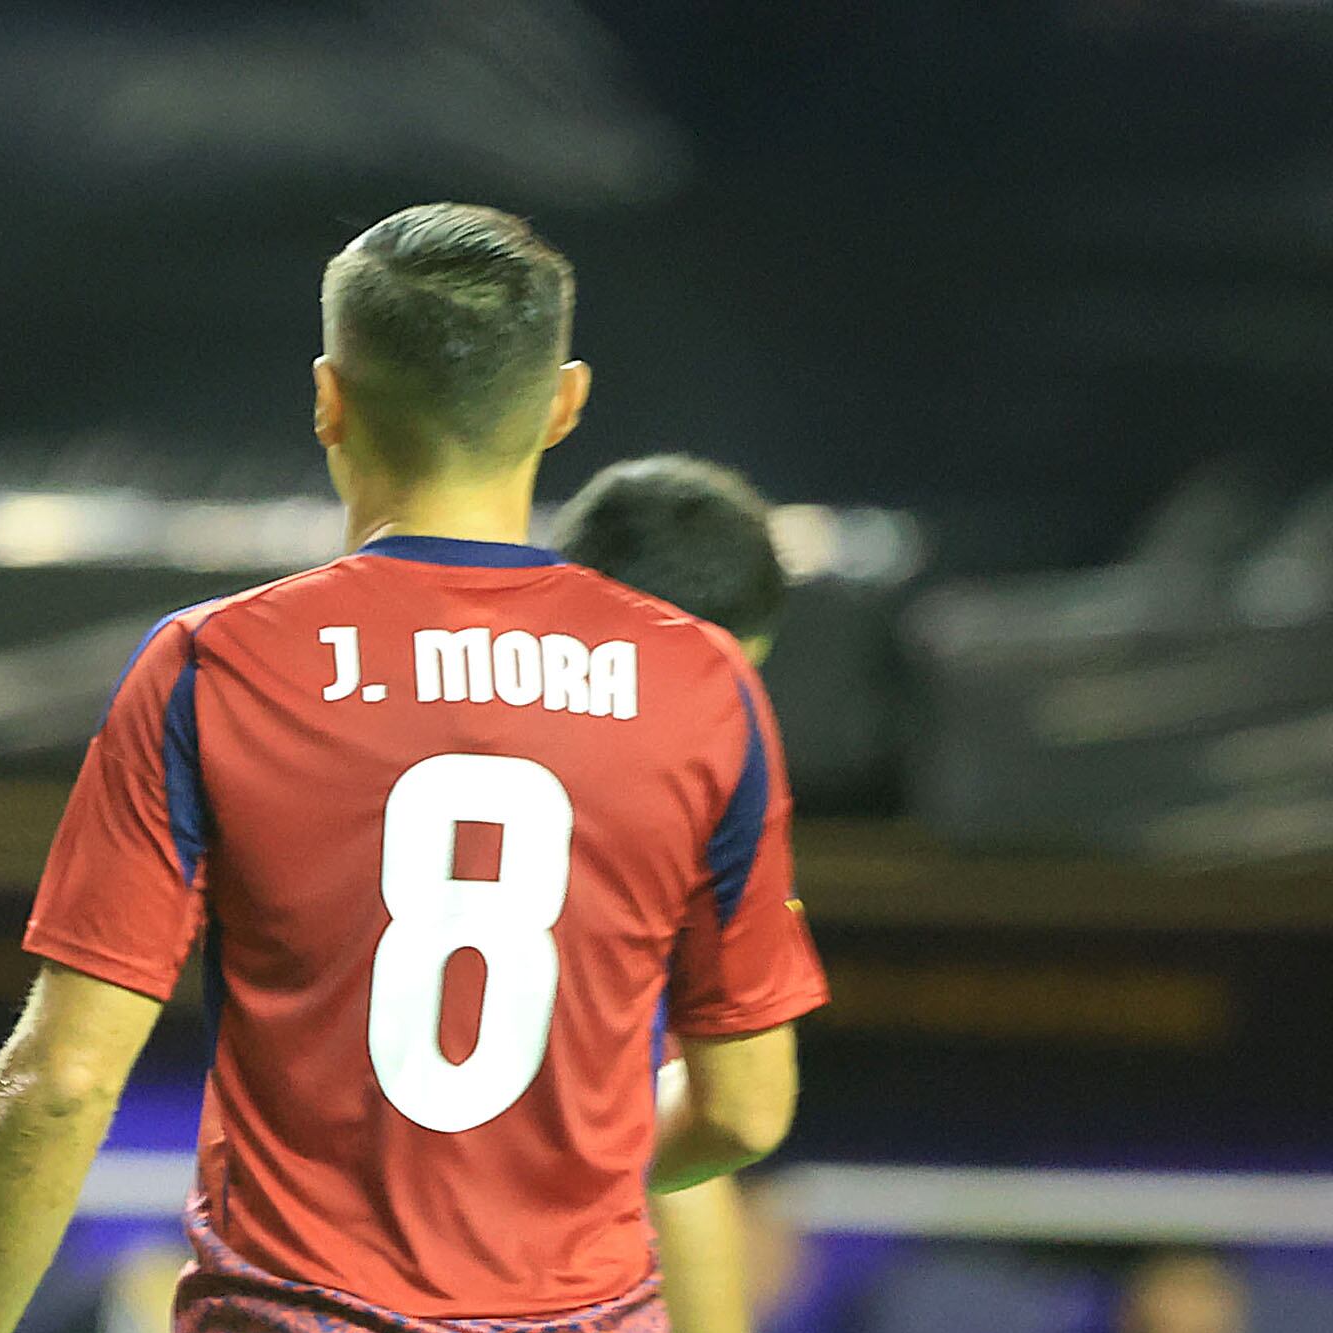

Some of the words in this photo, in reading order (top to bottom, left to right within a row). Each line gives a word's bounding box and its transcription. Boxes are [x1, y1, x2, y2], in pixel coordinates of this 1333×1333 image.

[319, 626, 388, 702] J.
[414, 627, 639, 720] MORA
[367, 752, 575, 1134] 8
